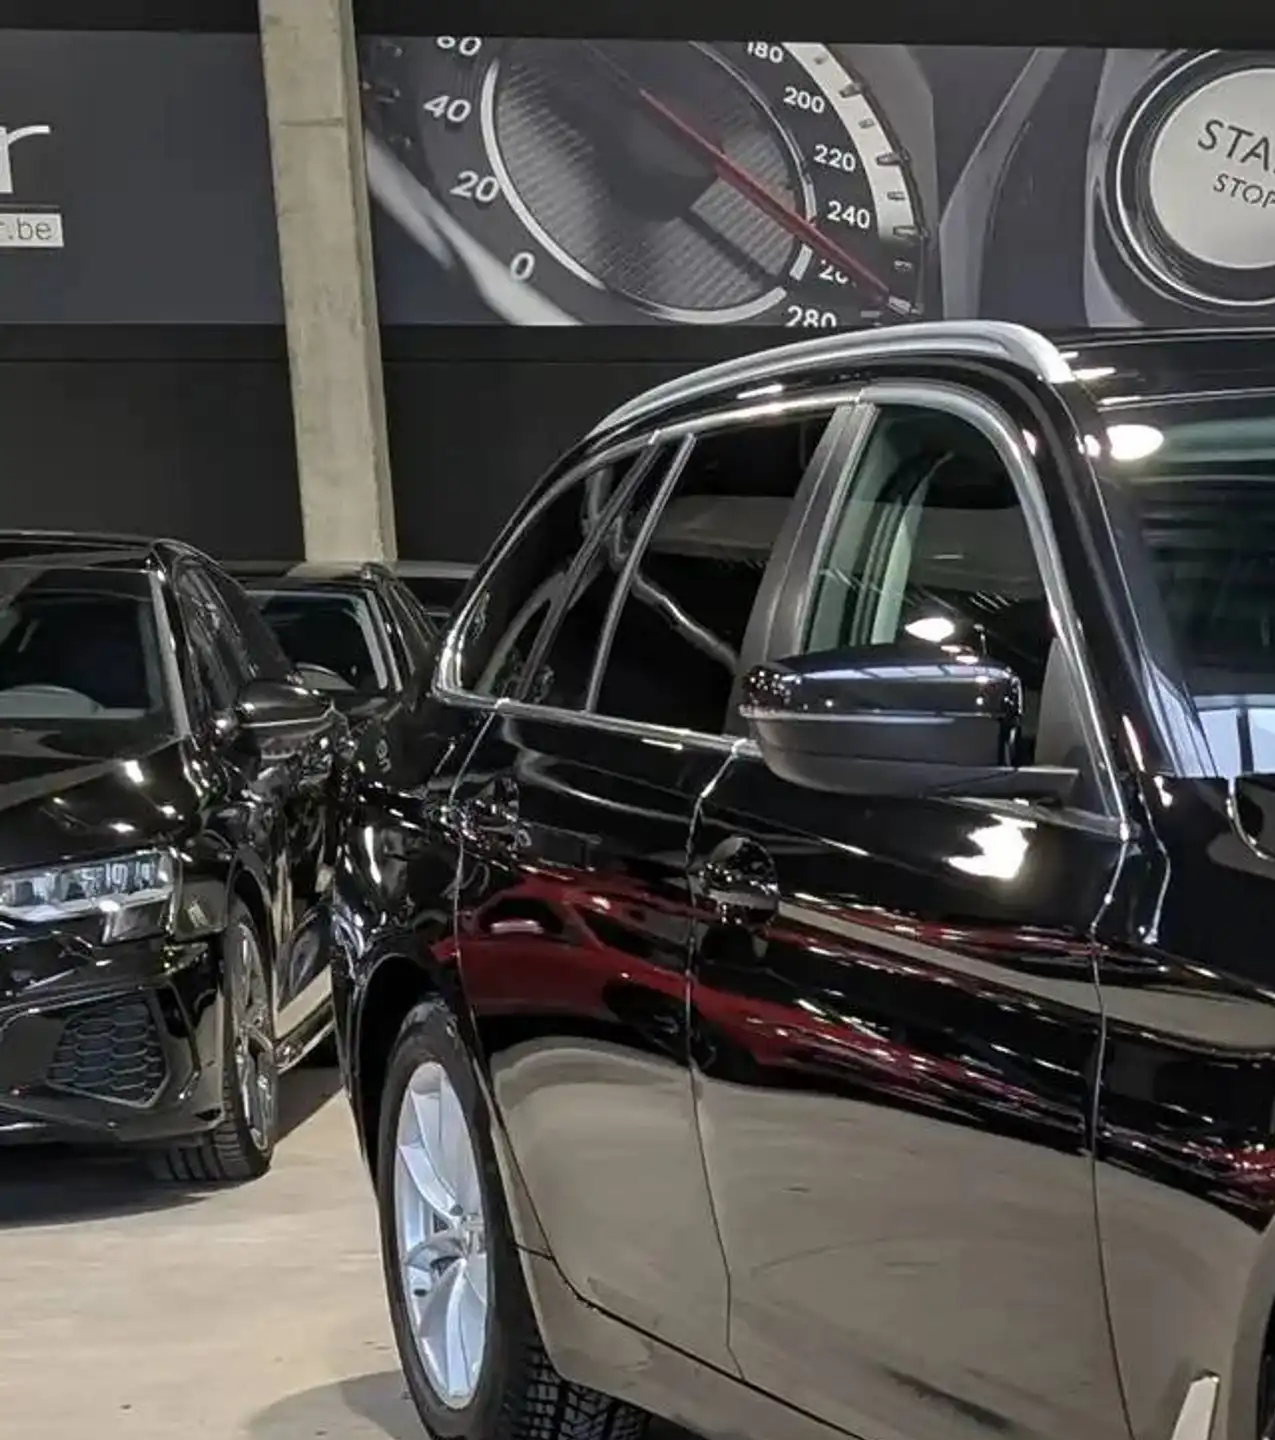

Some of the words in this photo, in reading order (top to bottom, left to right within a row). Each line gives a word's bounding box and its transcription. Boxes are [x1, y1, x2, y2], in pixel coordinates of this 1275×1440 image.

[747, 42, 784, 63] 180
[423, 95, 471, 122] 40
[783, 86, 825, 113] 200
[813, 144, 856, 172] 220
[450, 170, 499, 202] 20
[0, 215, 52, 241] .be
[827, 200, 870, 229] 240
[510, 252, 535, 280] 0
[785, 305, 837, 328] 280
